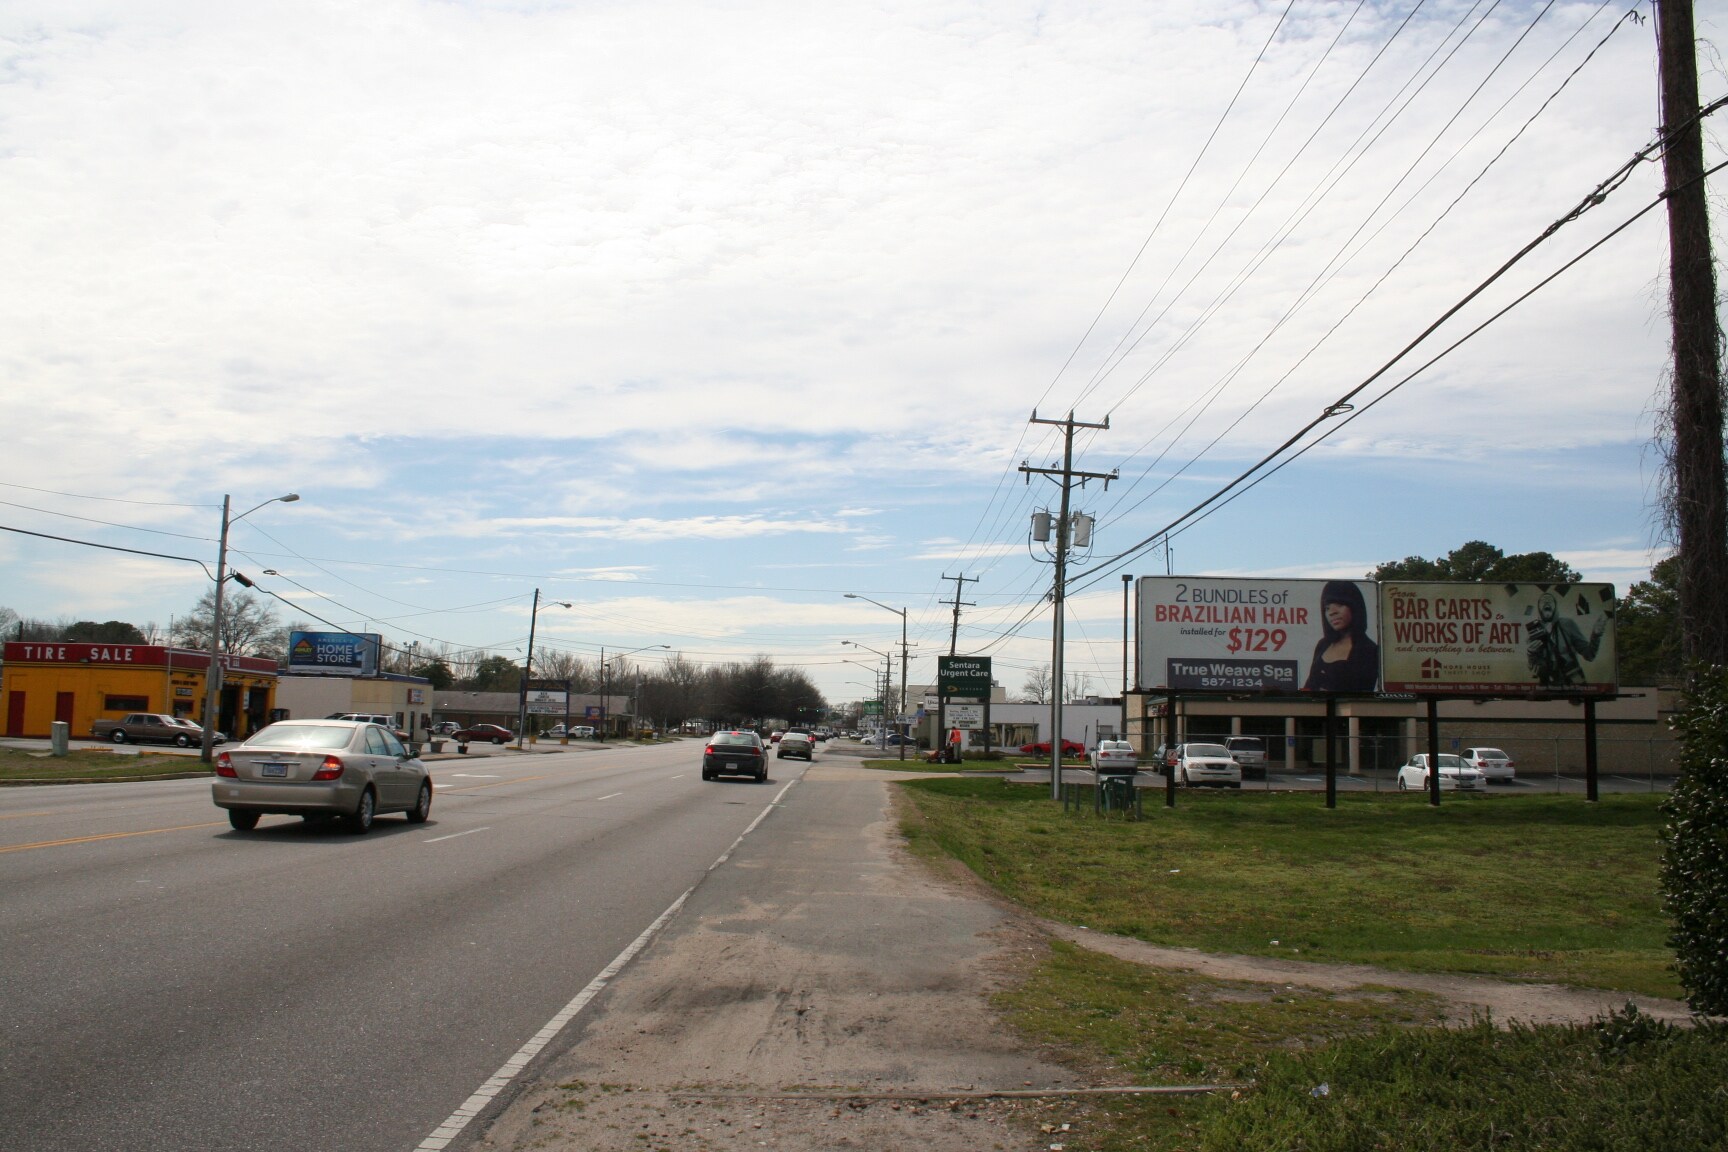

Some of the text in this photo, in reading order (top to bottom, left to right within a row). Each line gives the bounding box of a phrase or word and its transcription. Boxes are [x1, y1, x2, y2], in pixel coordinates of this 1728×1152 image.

[1175, 584, 1288, 604] 2 BUNDLES of
[1388, 588, 1417, 599] From
[1155, 605, 1308, 624] BRAZILIAN HAIR
[1393, 598, 1429, 620] BAR
[1435, 599, 1492, 620] CARTS
[1180, 627, 1226, 637] installed for
[1394, 622, 1522, 644] WORKS OF ART
[1226, 626, 1287, 654] $129
[24, 646, 132, 660] TIRE SALE
[317, 644, 353, 654] HOME
[1416, 645, 1463, 655] everything
[317, 654, 352, 663] STORE
[940, 669, 968, 678] Urgent
[1172, 663, 1293, 680] True Weave Spa
[1201, 678, 1263, 687] 587-1234
